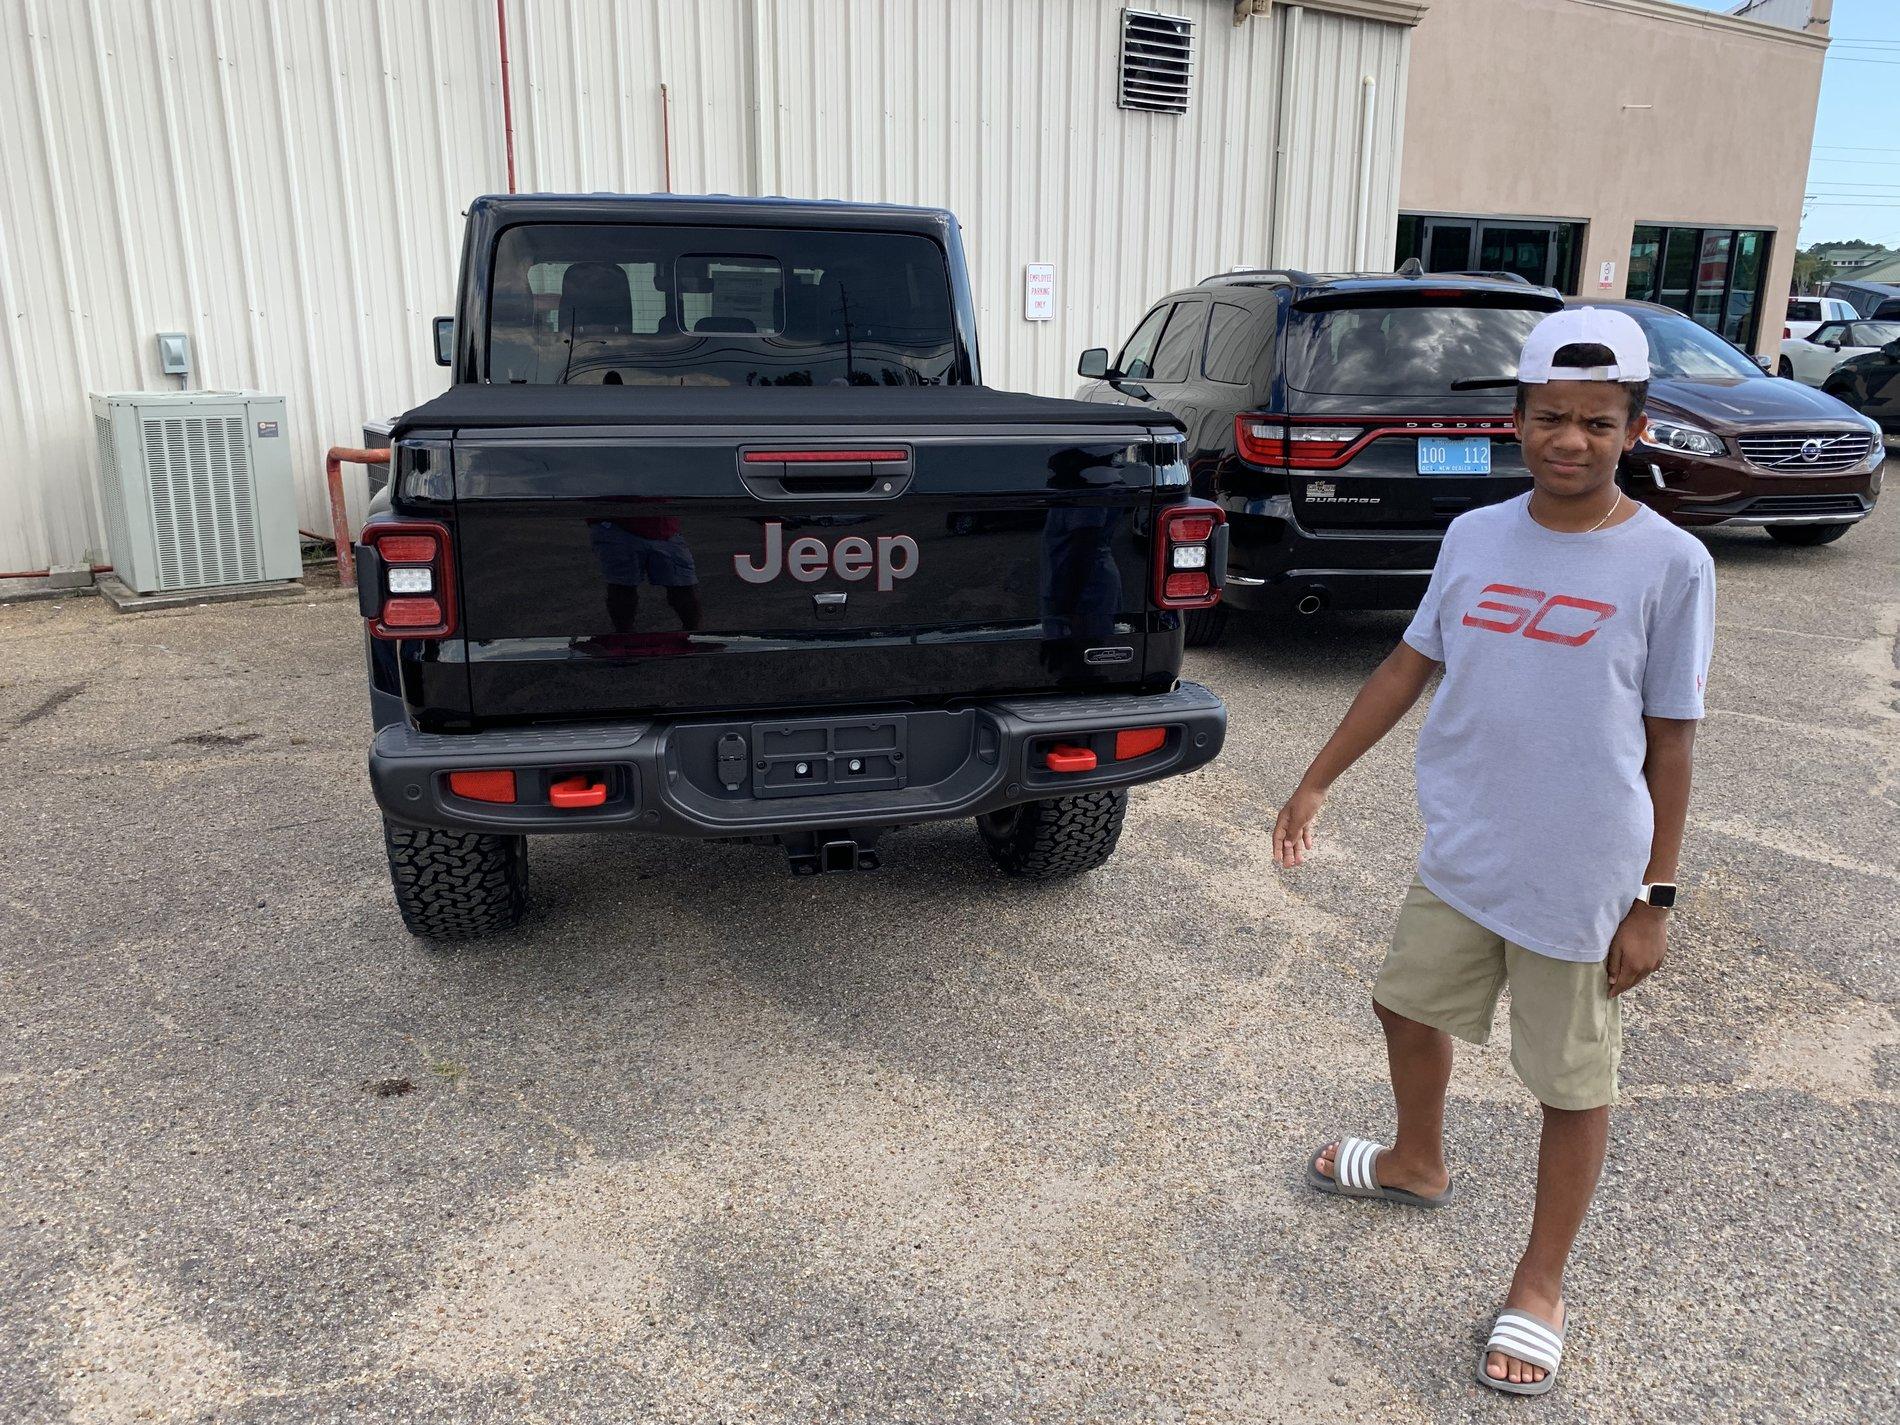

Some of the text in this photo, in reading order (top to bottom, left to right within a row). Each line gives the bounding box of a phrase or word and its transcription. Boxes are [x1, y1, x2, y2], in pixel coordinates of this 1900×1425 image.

[1029, 273, 1052, 283] EMPLOYEE
[1031, 287, 1050, 296] PARKING
[1034, 300, 1046, 309] ONLY
[1421, 447, 1488, 464] 100 112
[733, 521, 920, 592] Jeep
